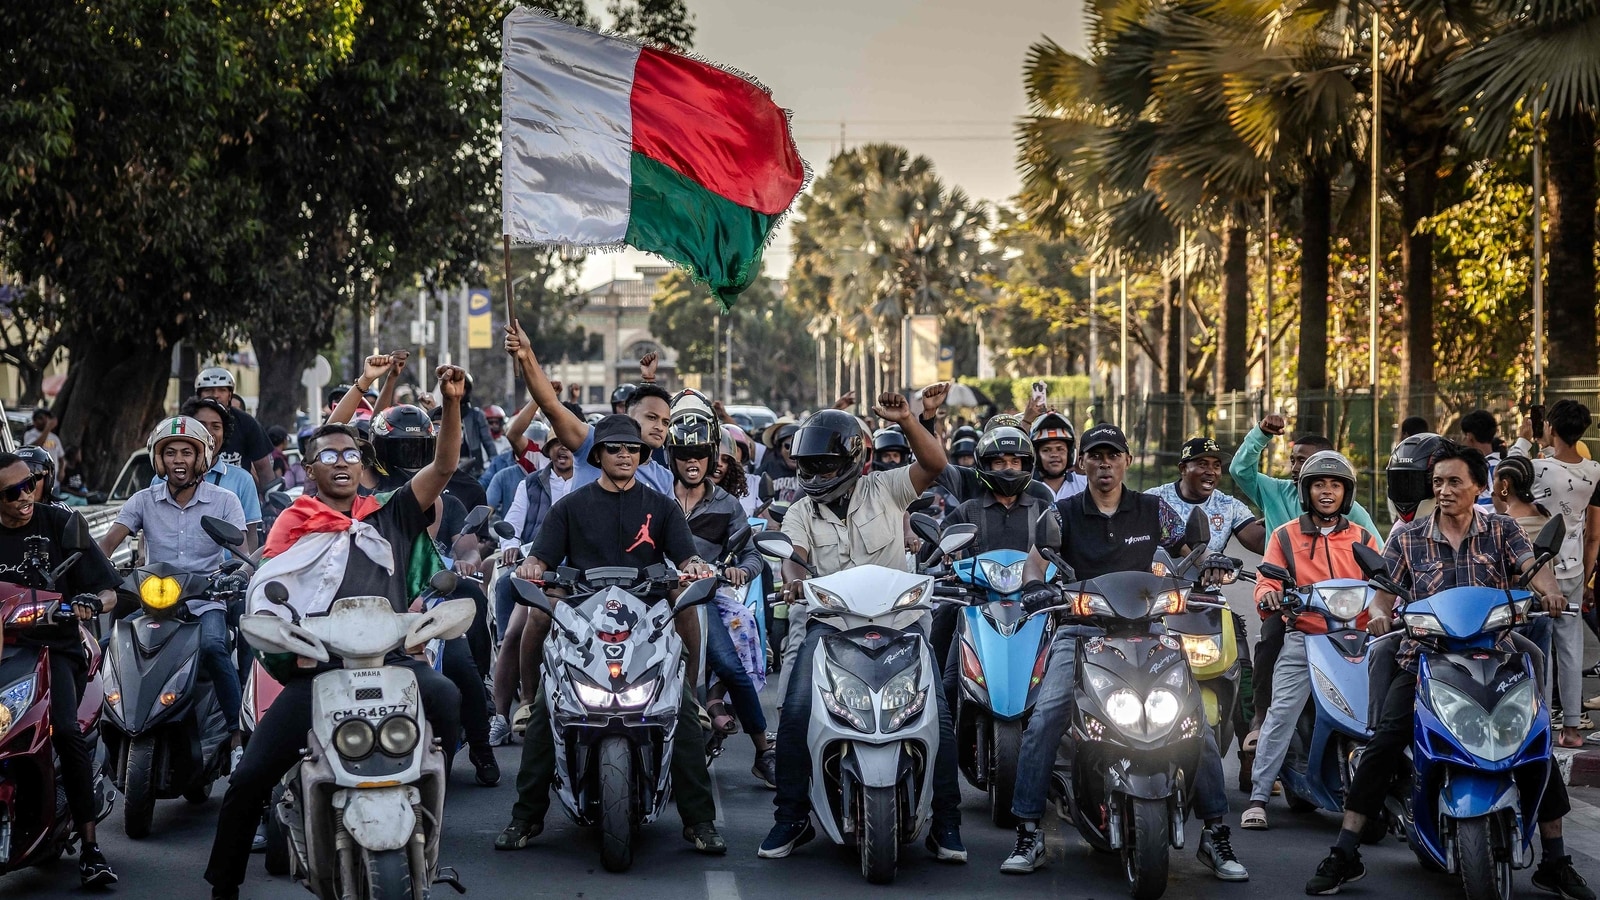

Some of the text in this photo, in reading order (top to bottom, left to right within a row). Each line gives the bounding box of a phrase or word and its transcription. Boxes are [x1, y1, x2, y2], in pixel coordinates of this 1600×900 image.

[352, 670, 381, 678] YAMAHA
[333, 704, 408, 721] CM 64877
